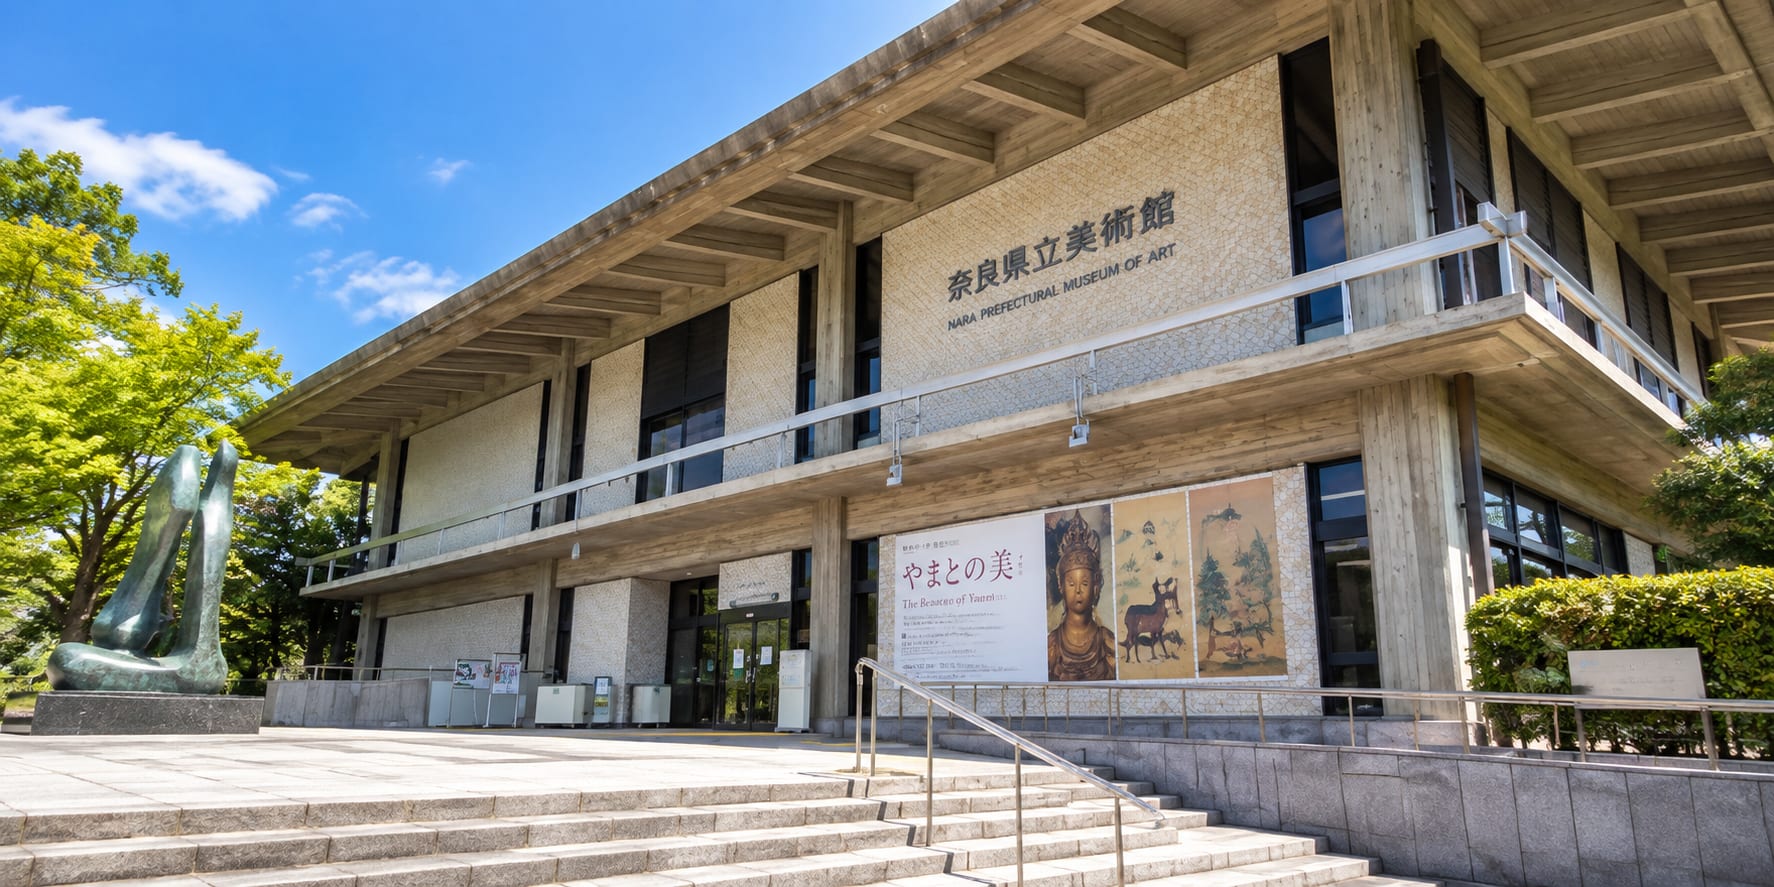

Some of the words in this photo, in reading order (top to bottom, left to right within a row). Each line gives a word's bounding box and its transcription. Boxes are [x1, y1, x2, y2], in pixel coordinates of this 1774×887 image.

[947, 189, 1175, 303] 奈良県立美術館
[947, 314, 977, 331] NARA
[980, 284, 1059, 320] PREFECTURAL
[1063, 262, 1120, 293] MUSEUM
[1124, 254, 1143, 272] OF
[1147, 242, 1177, 265] ART
[902, 548, 1013, 590] やまとの美
[902, 599, 918, 609] The
